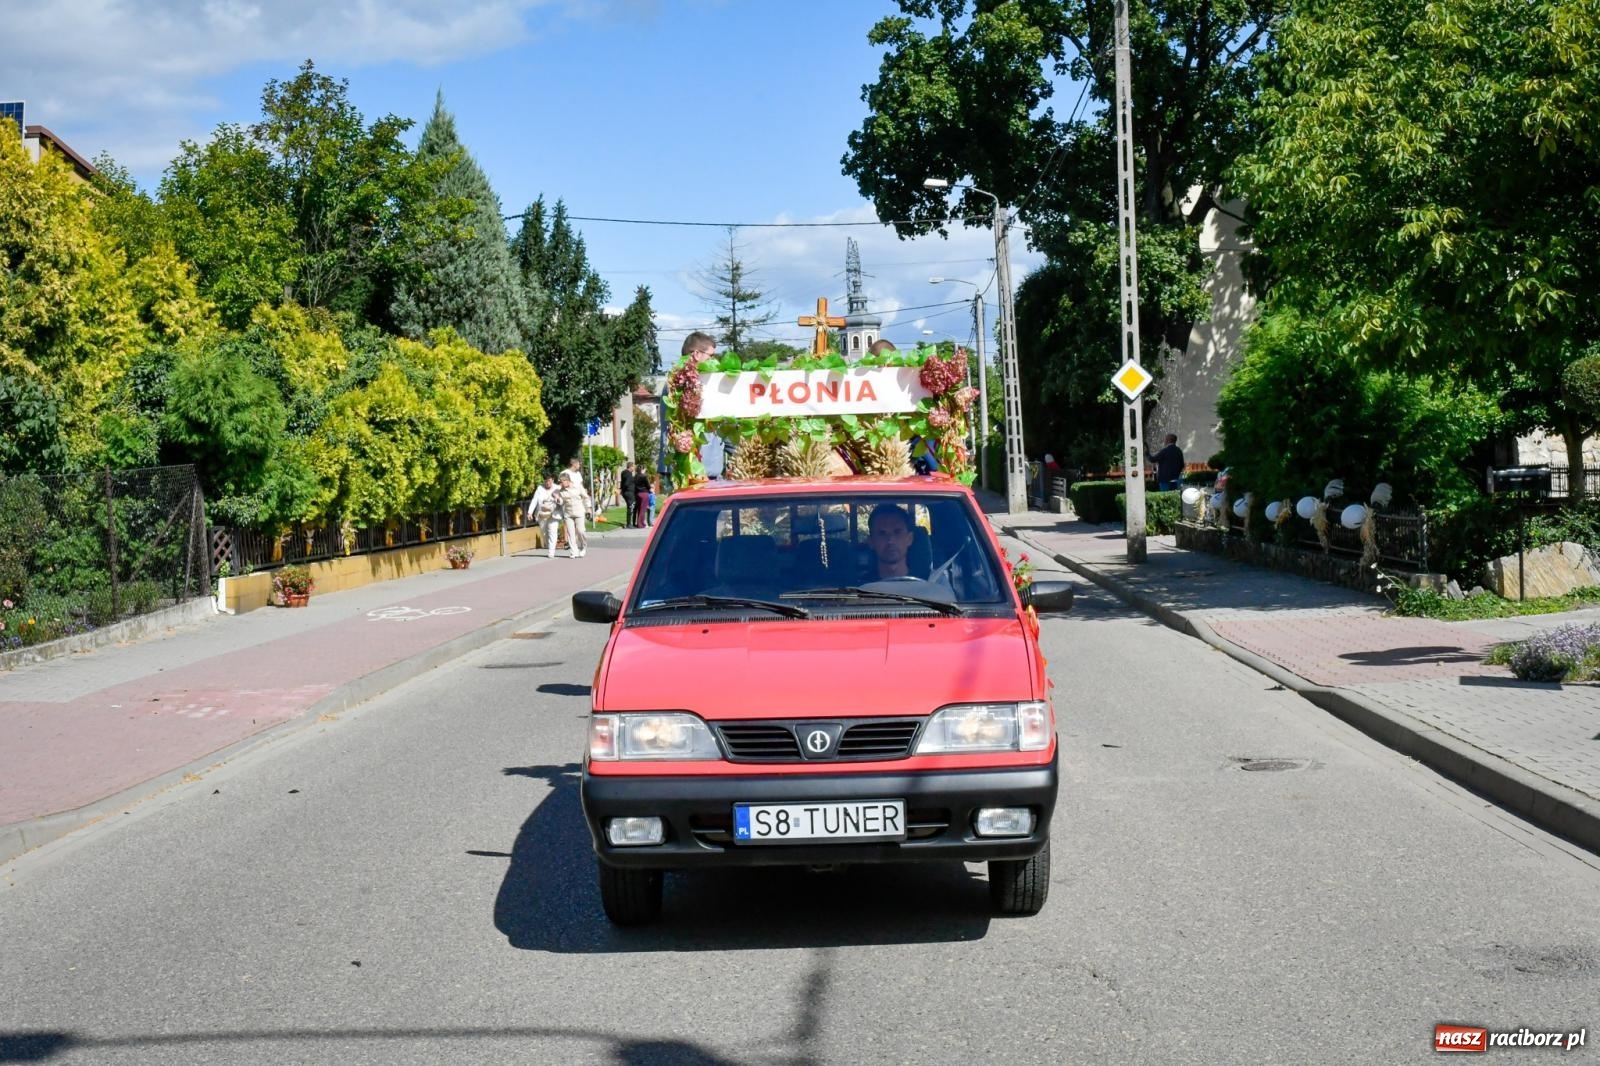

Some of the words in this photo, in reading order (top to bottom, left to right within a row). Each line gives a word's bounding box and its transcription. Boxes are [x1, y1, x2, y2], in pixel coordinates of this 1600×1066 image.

[749, 380, 877, 405] PŁONIA
[755, 809, 790, 836] S8
[804, 805, 899, 834] TUNER
